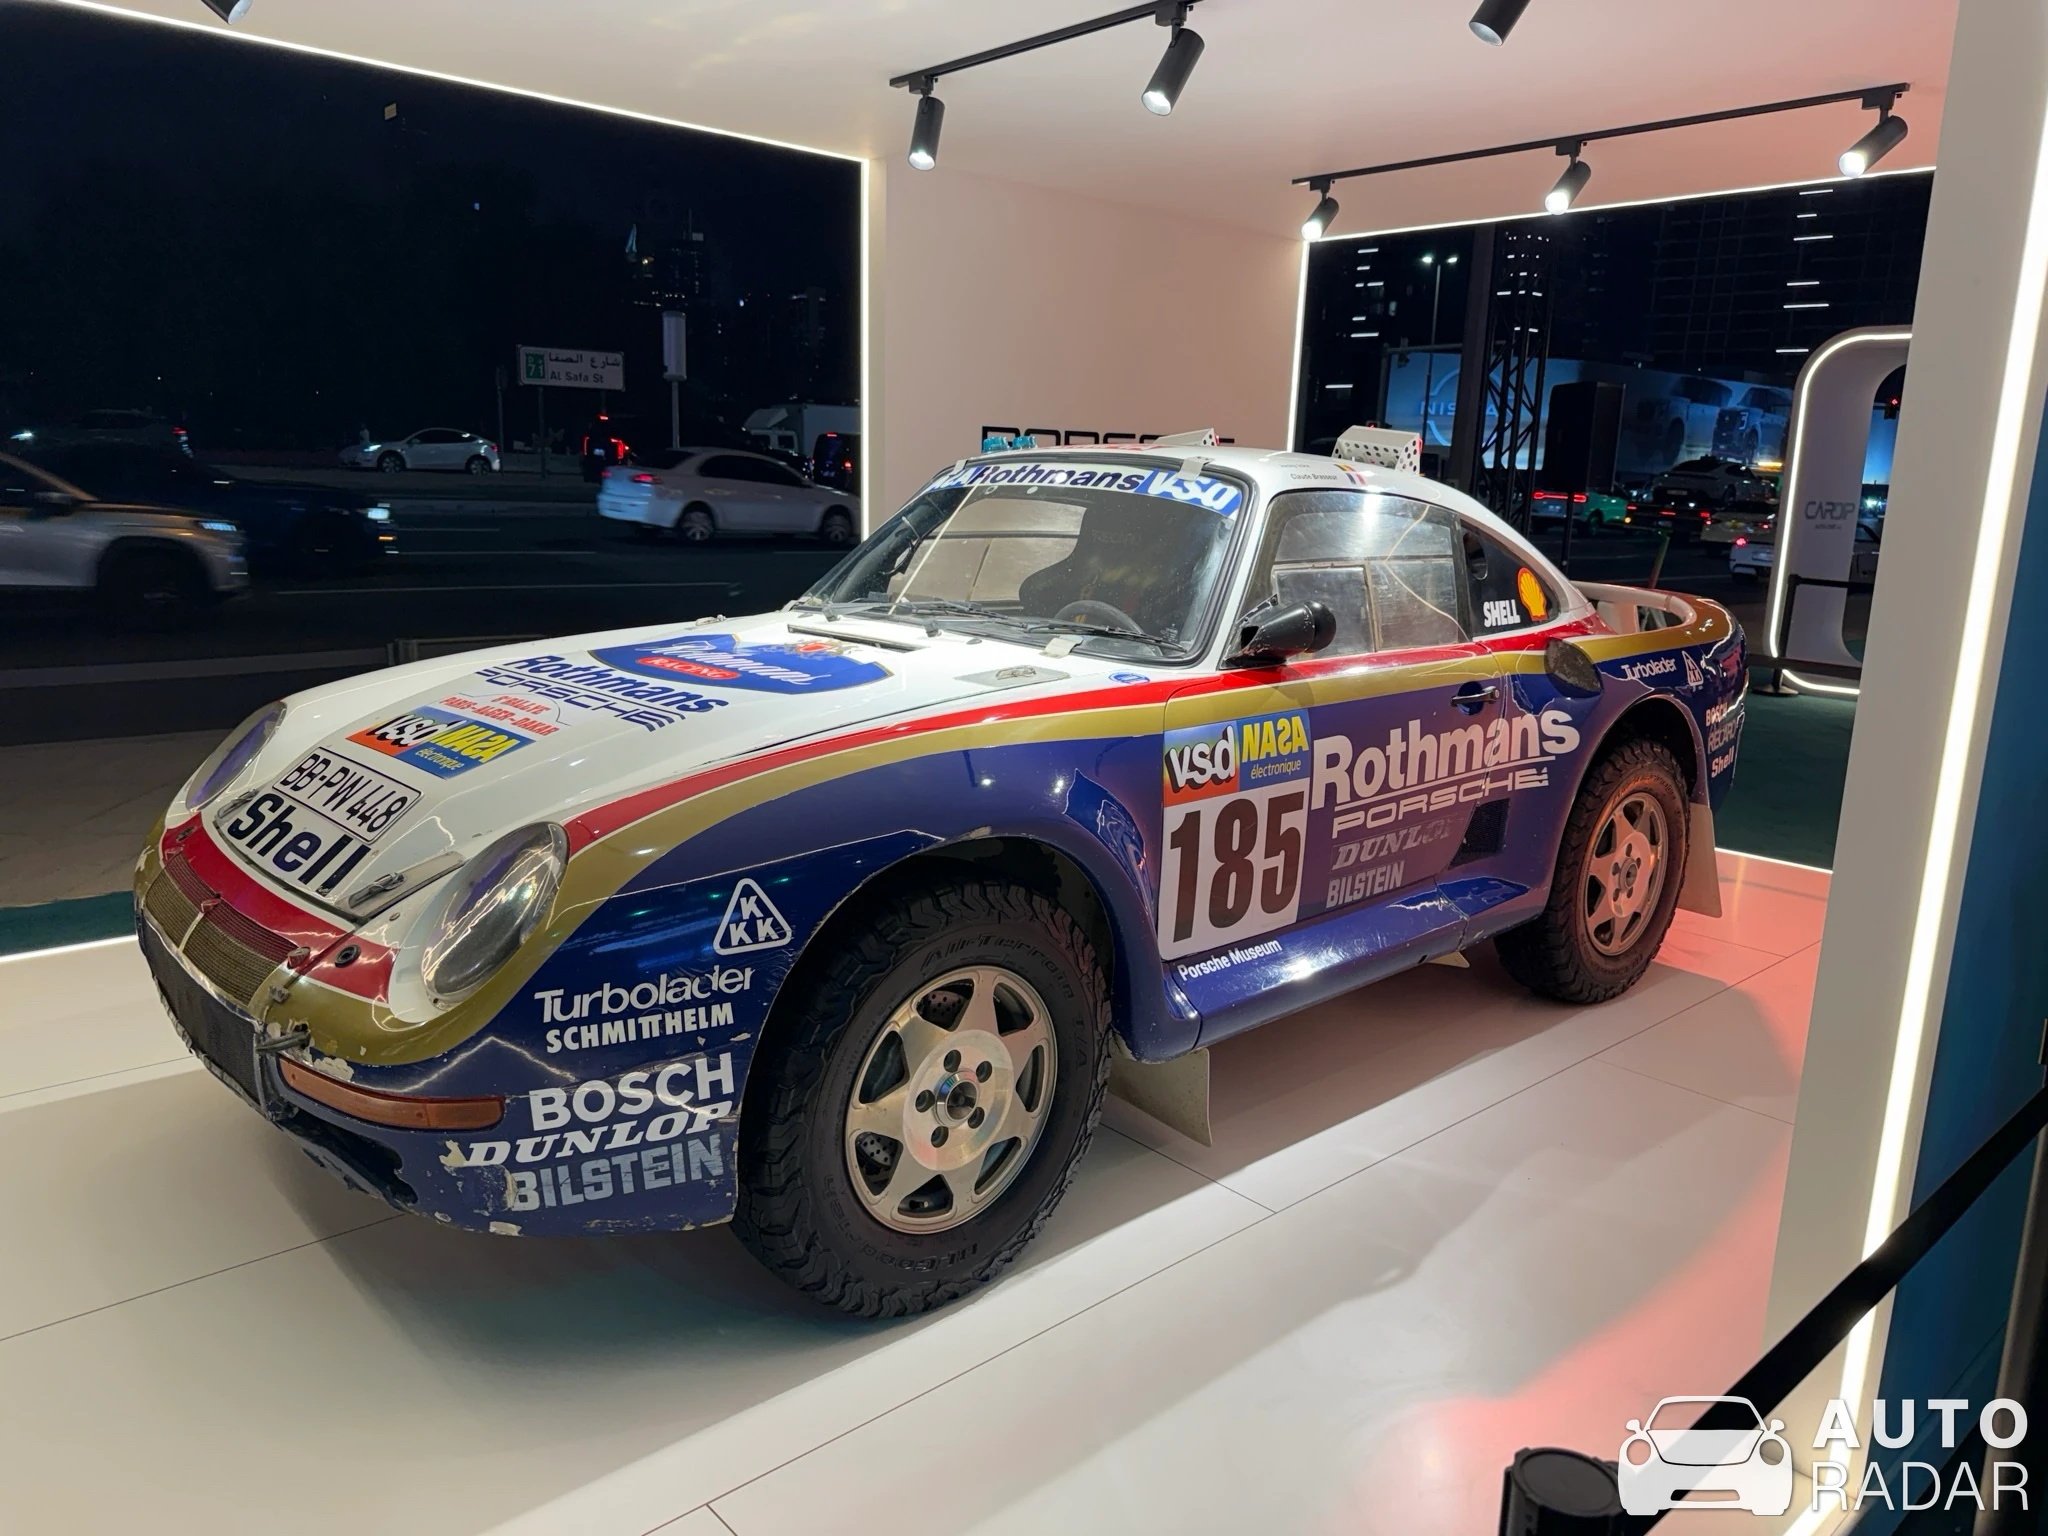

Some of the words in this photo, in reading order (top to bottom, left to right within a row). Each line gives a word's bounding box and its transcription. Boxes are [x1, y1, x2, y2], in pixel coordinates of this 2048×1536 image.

[527, 363, 545, 377] 71
[549, 351, 583, 364] الصفا
[565, 371, 589, 383] Safa
[592, 373, 605, 384] St
[590, 354, 621, 369] شارع
[1420, 401, 1514, 417] NISA
[965, 464, 1145, 491] Rothmans
[1483, 599, 1521, 628] SHELL
[502, 656, 729, 713] Rothmans
[648, 657, 732, 680] RACING
[1620, 657, 1677, 681] Turbolader
[475, 669, 675, 732] PORSCHE
[1706, 702, 1728, 727] BOSCH
[1250, 759, 1302, 781] électronique
[1311, 710, 1581, 811] Rothmans
[1711, 746, 1735, 778] Shell
[1331, 767, 1550, 839] PORSCHE
[227, 792, 372, 897] Shell
[1169, 791, 1306, 944] 185
[1325, 861, 1405, 909] BILSTEIN
[1176, 949, 1231, 982] Porsche
[1228, 938, 1283, 972] Museum
[533, 965, 756, 1024] Turbolader
[546, 1002, 735, 1054] SCHMITTHELM
[529, 1052, 735, 1131] BOSCH
[463, 1101, 734, 1167] DUNLOP
[511, 1134, 725, 1212] BILSTEIN
